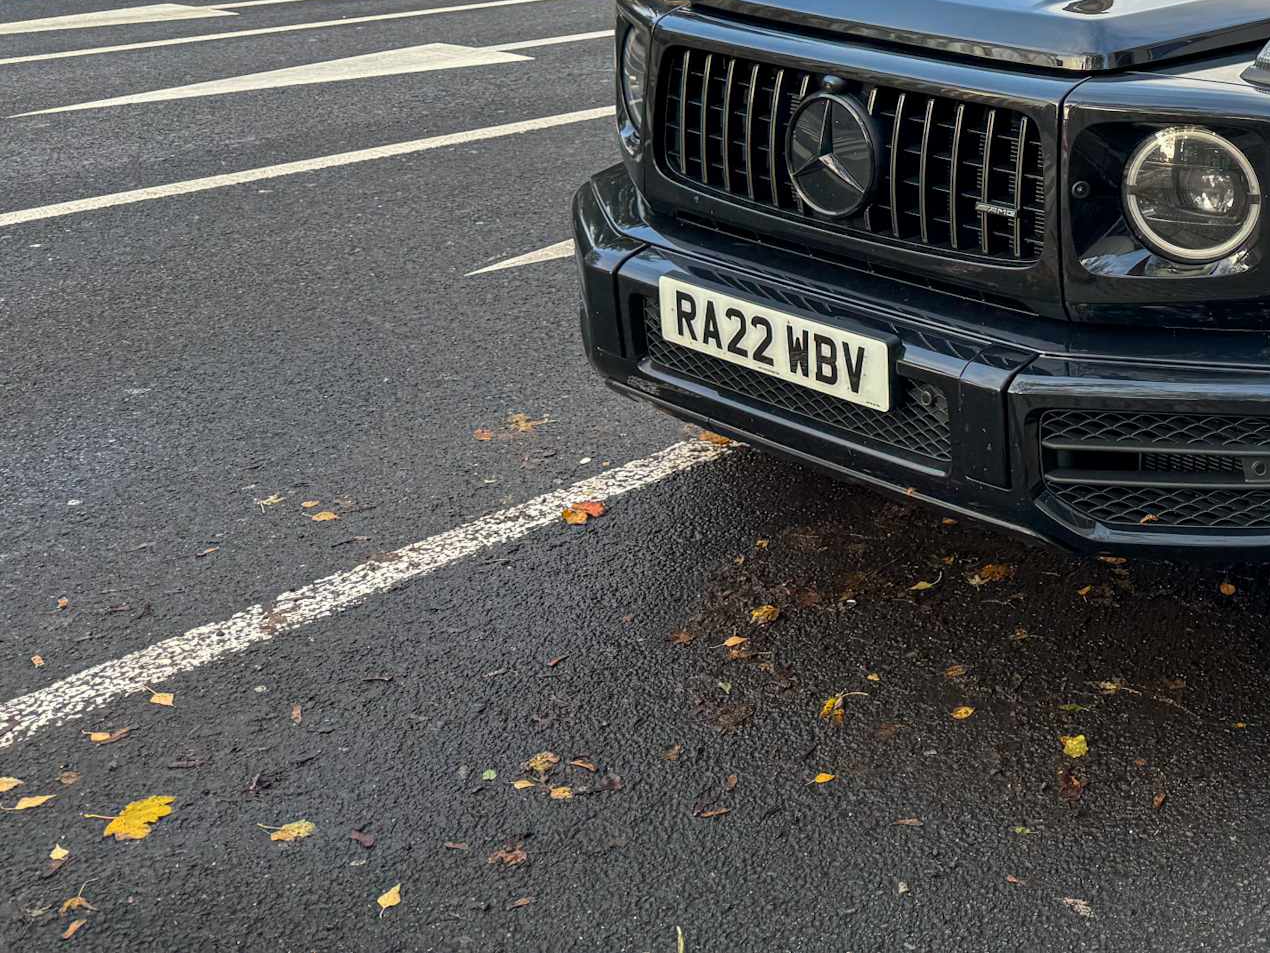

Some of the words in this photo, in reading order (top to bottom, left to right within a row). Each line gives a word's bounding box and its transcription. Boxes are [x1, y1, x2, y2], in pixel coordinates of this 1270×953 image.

[988, 205, 1016, 218] AMG
[675, 289, 774, 367] RA22
[786, 324, 865, 394] WBV
